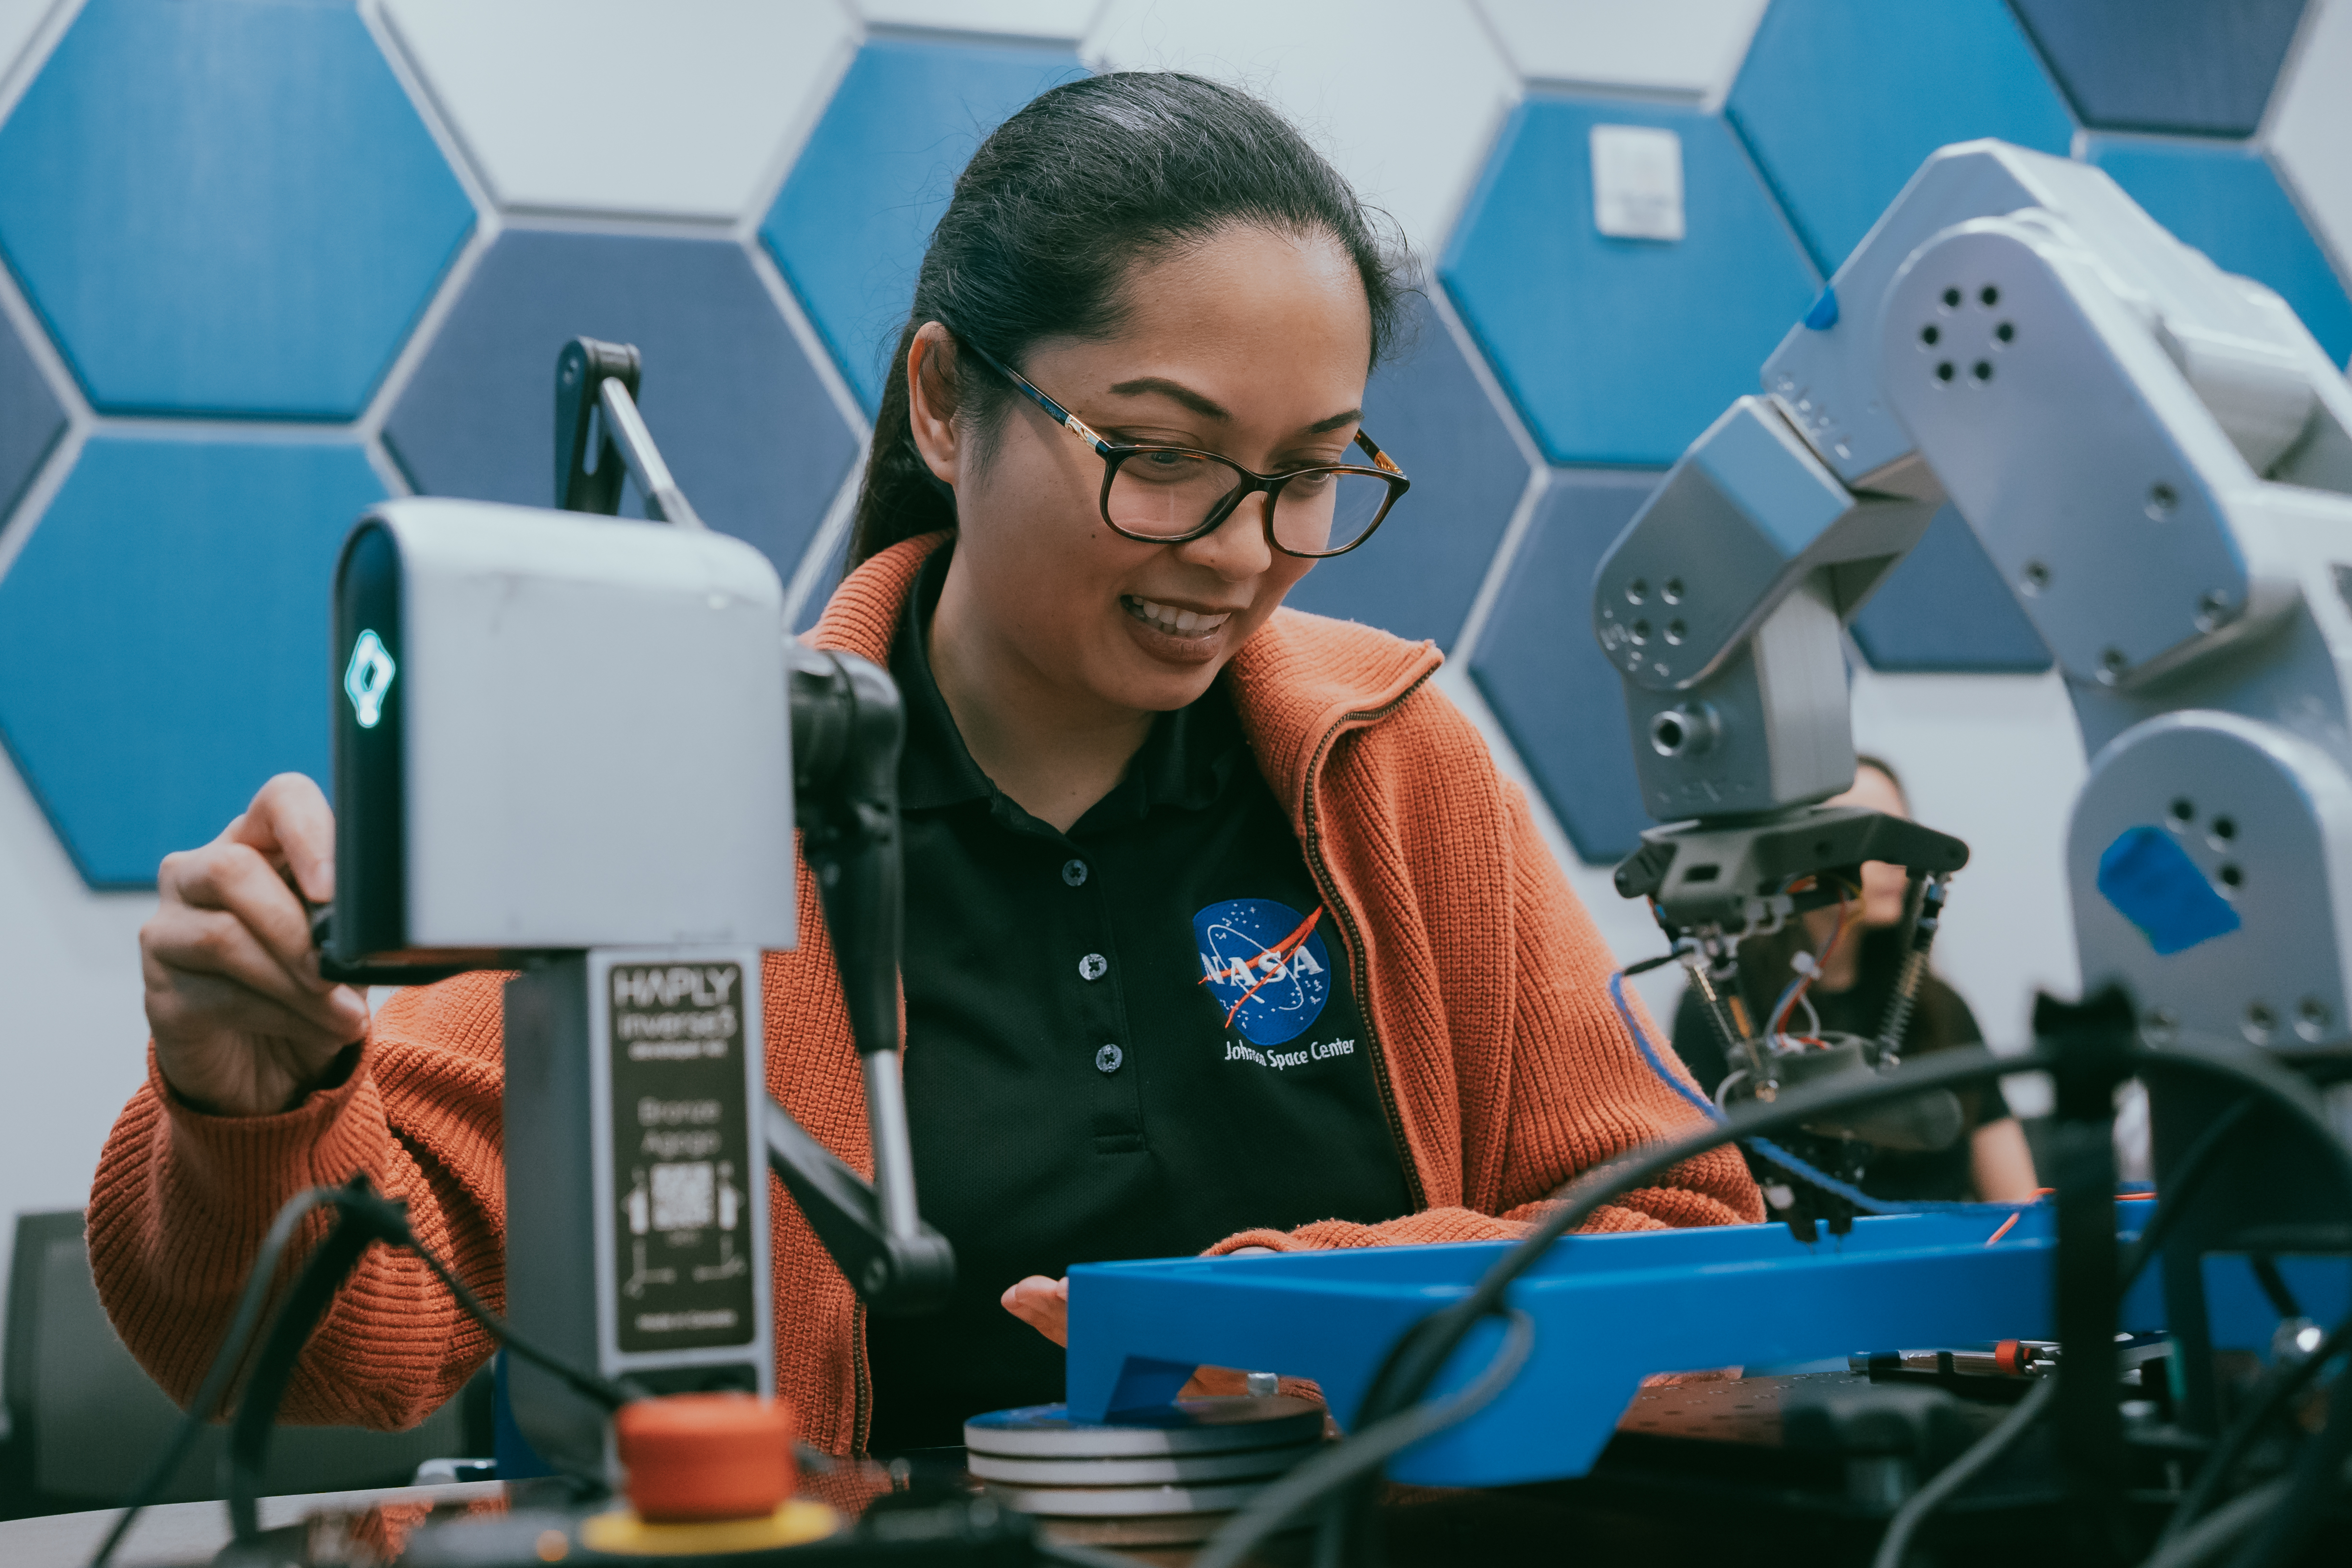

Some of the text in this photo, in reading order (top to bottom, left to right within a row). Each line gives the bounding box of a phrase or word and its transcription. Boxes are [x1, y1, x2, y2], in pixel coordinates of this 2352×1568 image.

[1200, 945, 1325, 987] NASA
[615, 968, 737, 1006] HAPLY
[1225, 1038, 1355, 1070] John Space Center
